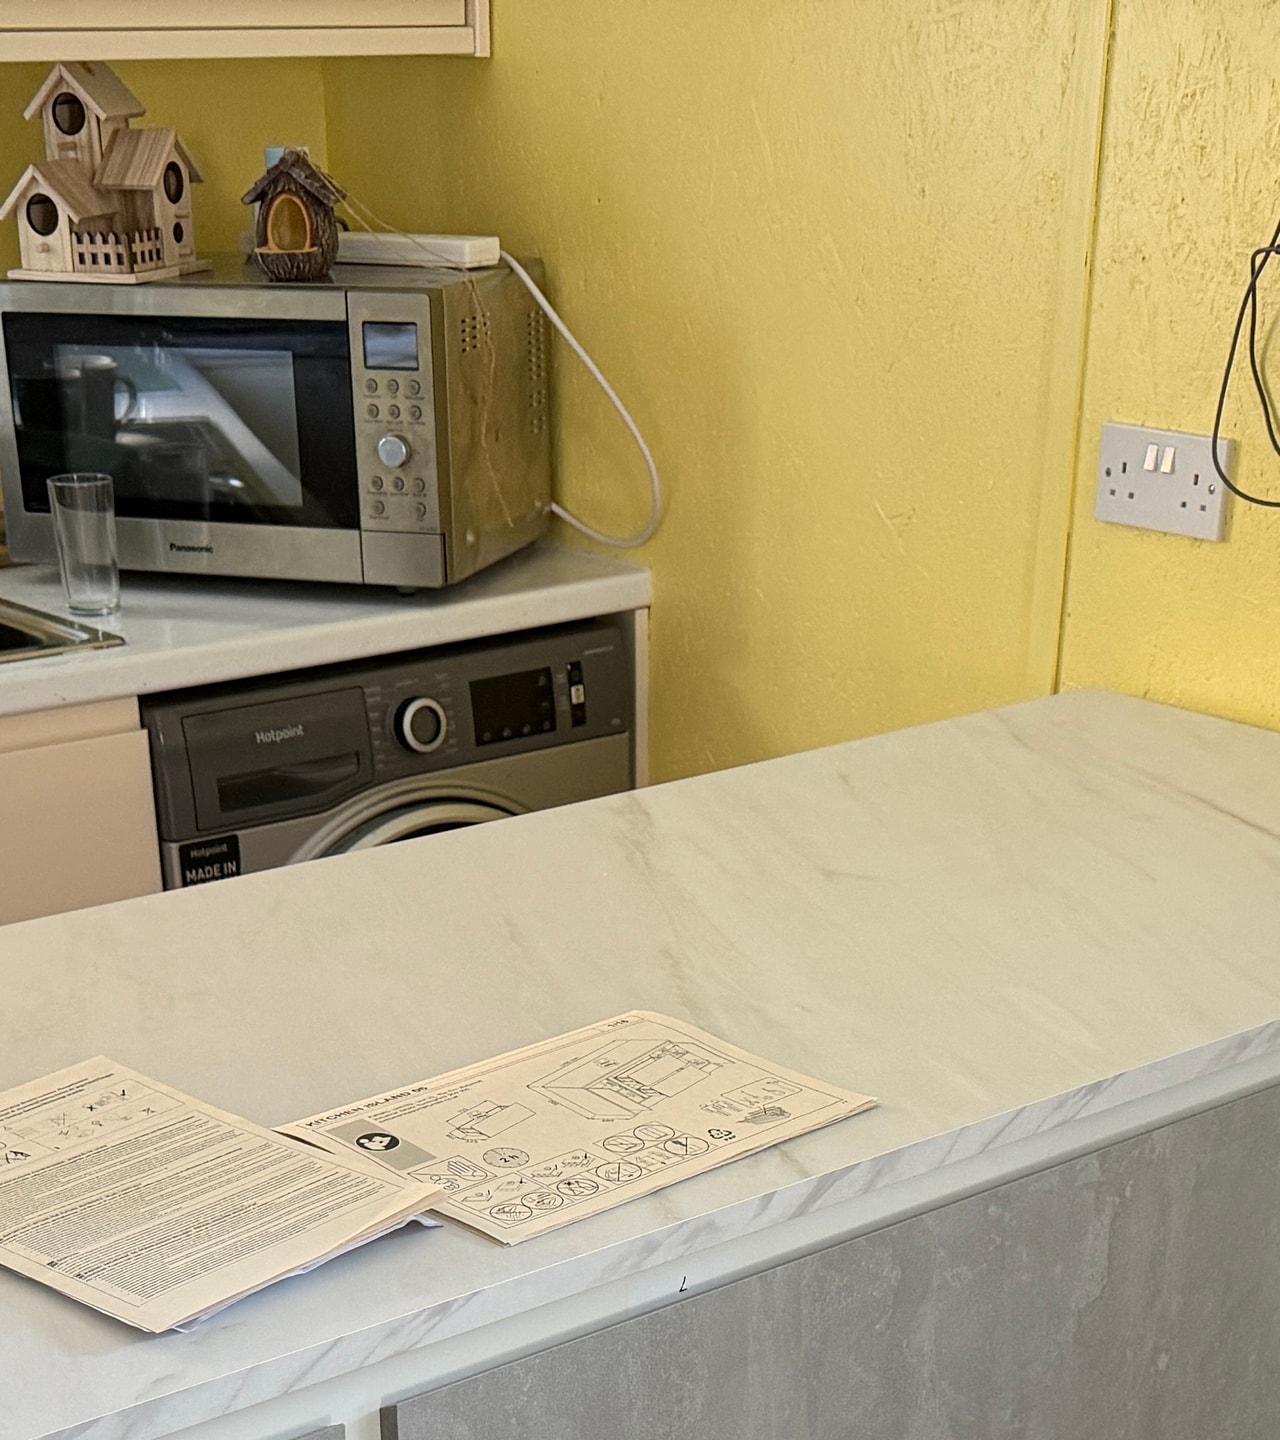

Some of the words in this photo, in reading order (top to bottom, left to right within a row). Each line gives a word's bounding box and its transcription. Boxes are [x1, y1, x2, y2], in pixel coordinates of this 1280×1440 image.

[169, 543, 214, 554] Panasonic
[255, 724, 305, 744] Hotpoint
[186, 865, 222, 883] MADE
[223, 860, 238, 874] IN
[305, 1107, 364, 1127] KITCHEN
